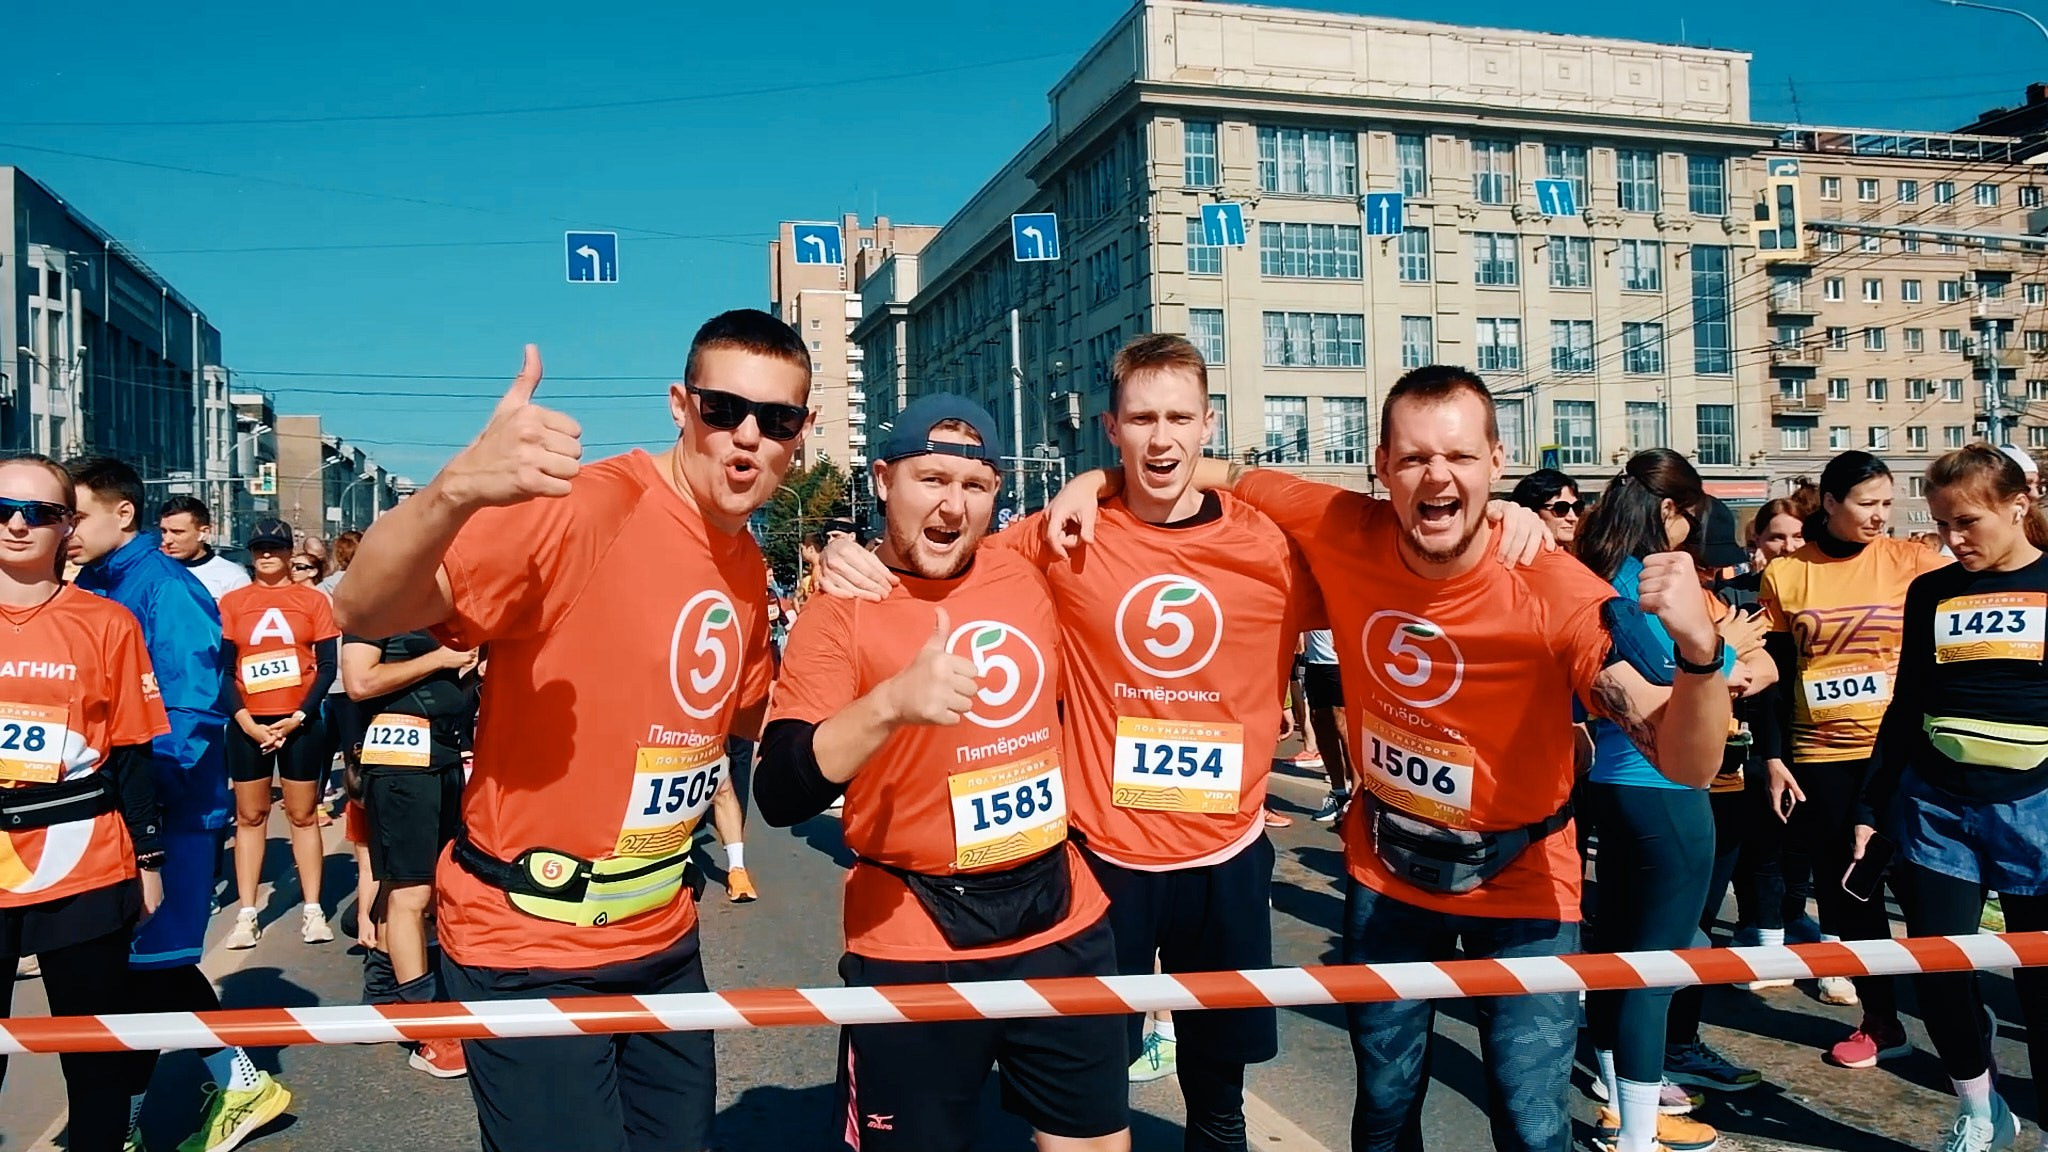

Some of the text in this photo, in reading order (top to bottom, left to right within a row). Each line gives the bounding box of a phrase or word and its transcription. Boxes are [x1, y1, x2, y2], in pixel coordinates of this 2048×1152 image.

[1143, 583, 1201, 658] 5
[1949, 610, 2026, 636] 1423
[690, 602, 733, 694] 5
[1383, 622, 1443, 687] 5
[0, 661, 77, 681] АГНИТ
[251, 660, 290, 678] 1631
[971, 625, 1021, 707] 5
[1114, 682, 1221, 704] Пятёрочка
[1814, 676, 1877, 701] 1304
[1, 723, 46, 752] 28
[371, 727, 420, 746] 1228
[956, 727, 1050, 763] Пятёрочка
[1134, 725, 1220, 737] ПОЛУМАРАФОН
[1132, 742, 1223, 779] 1254
[1371, 736, 1455, 795] 1506
[643, 764, 721, 816] 1505
[971, 777, 1053, 832] 1583
[1203, 792, 1233, 800] VIRA
[545, 862, 559, 877] 5
